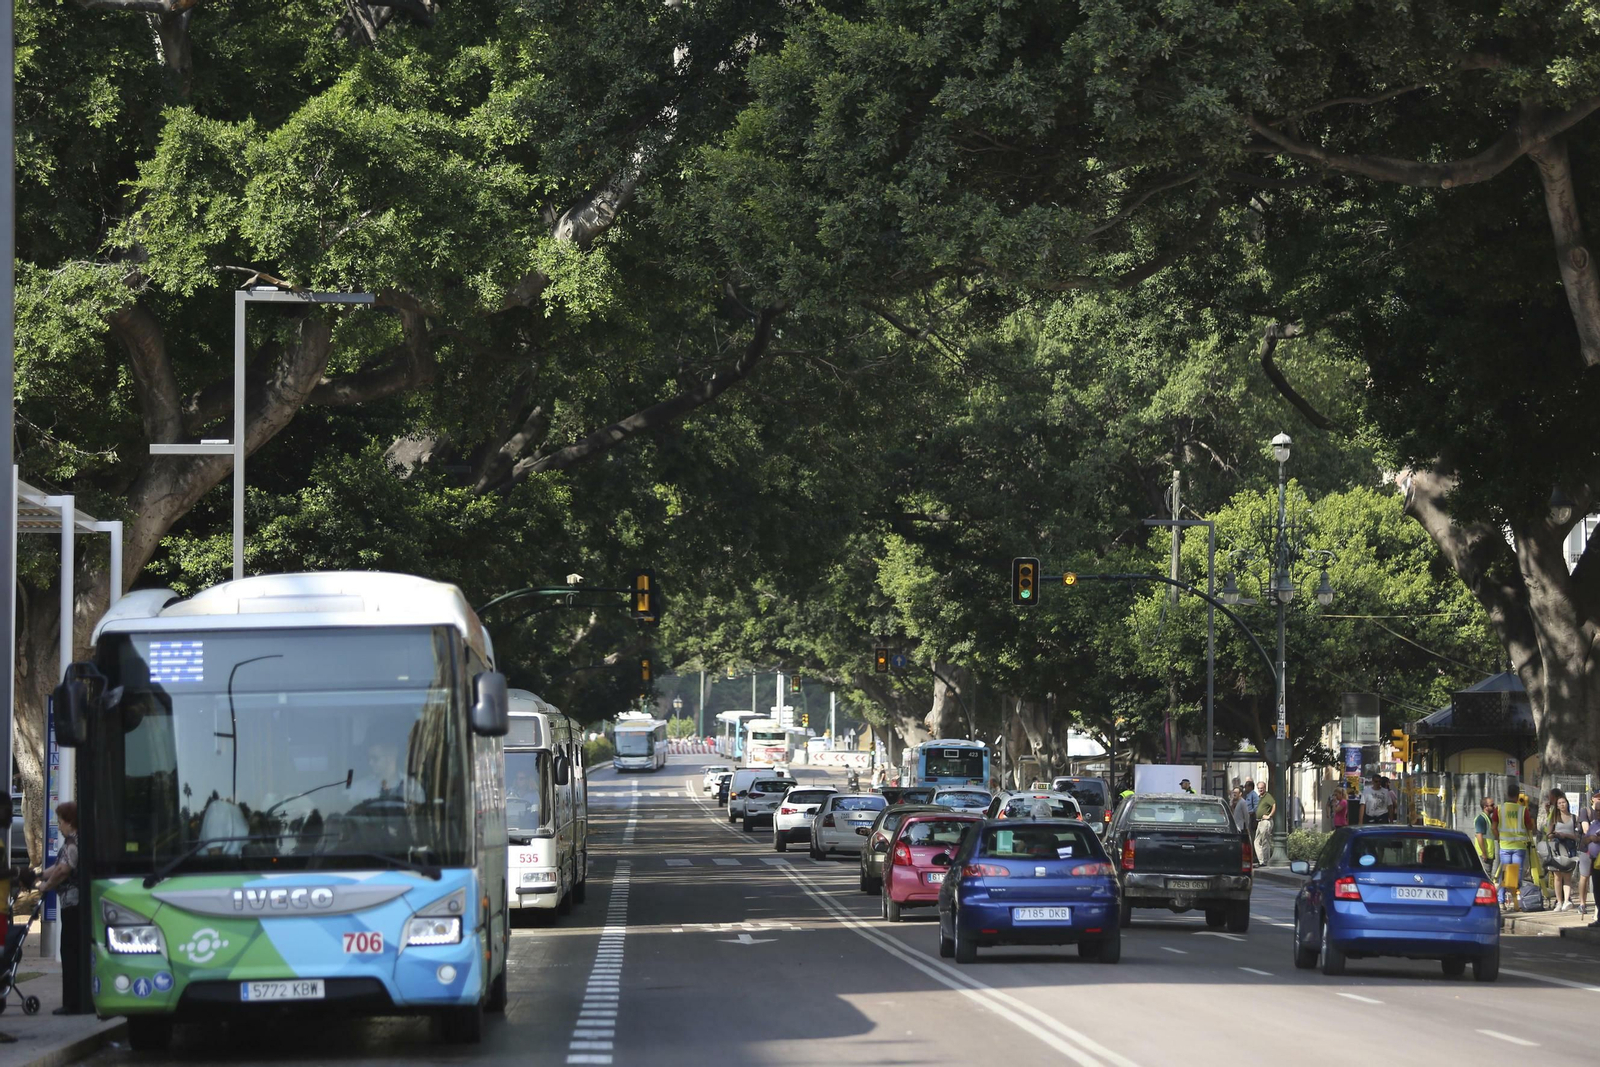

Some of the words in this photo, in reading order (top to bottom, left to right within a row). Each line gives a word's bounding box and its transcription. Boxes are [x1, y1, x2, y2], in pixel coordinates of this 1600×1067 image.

[519, 853, 539, 864] 535
[233, 888, 334, 911] IVECO
[1398, 888, 1423, 898] 0307
[1426, 889, 1446, 899] KKR
[1020, 908, 1045, 918] 7185
[1048, 908, 1067, 918] DKB
[343, 932, 382, 953] 706
[253, 983, 288, 998] 5772
[293, 981, 318, 997] KBW
